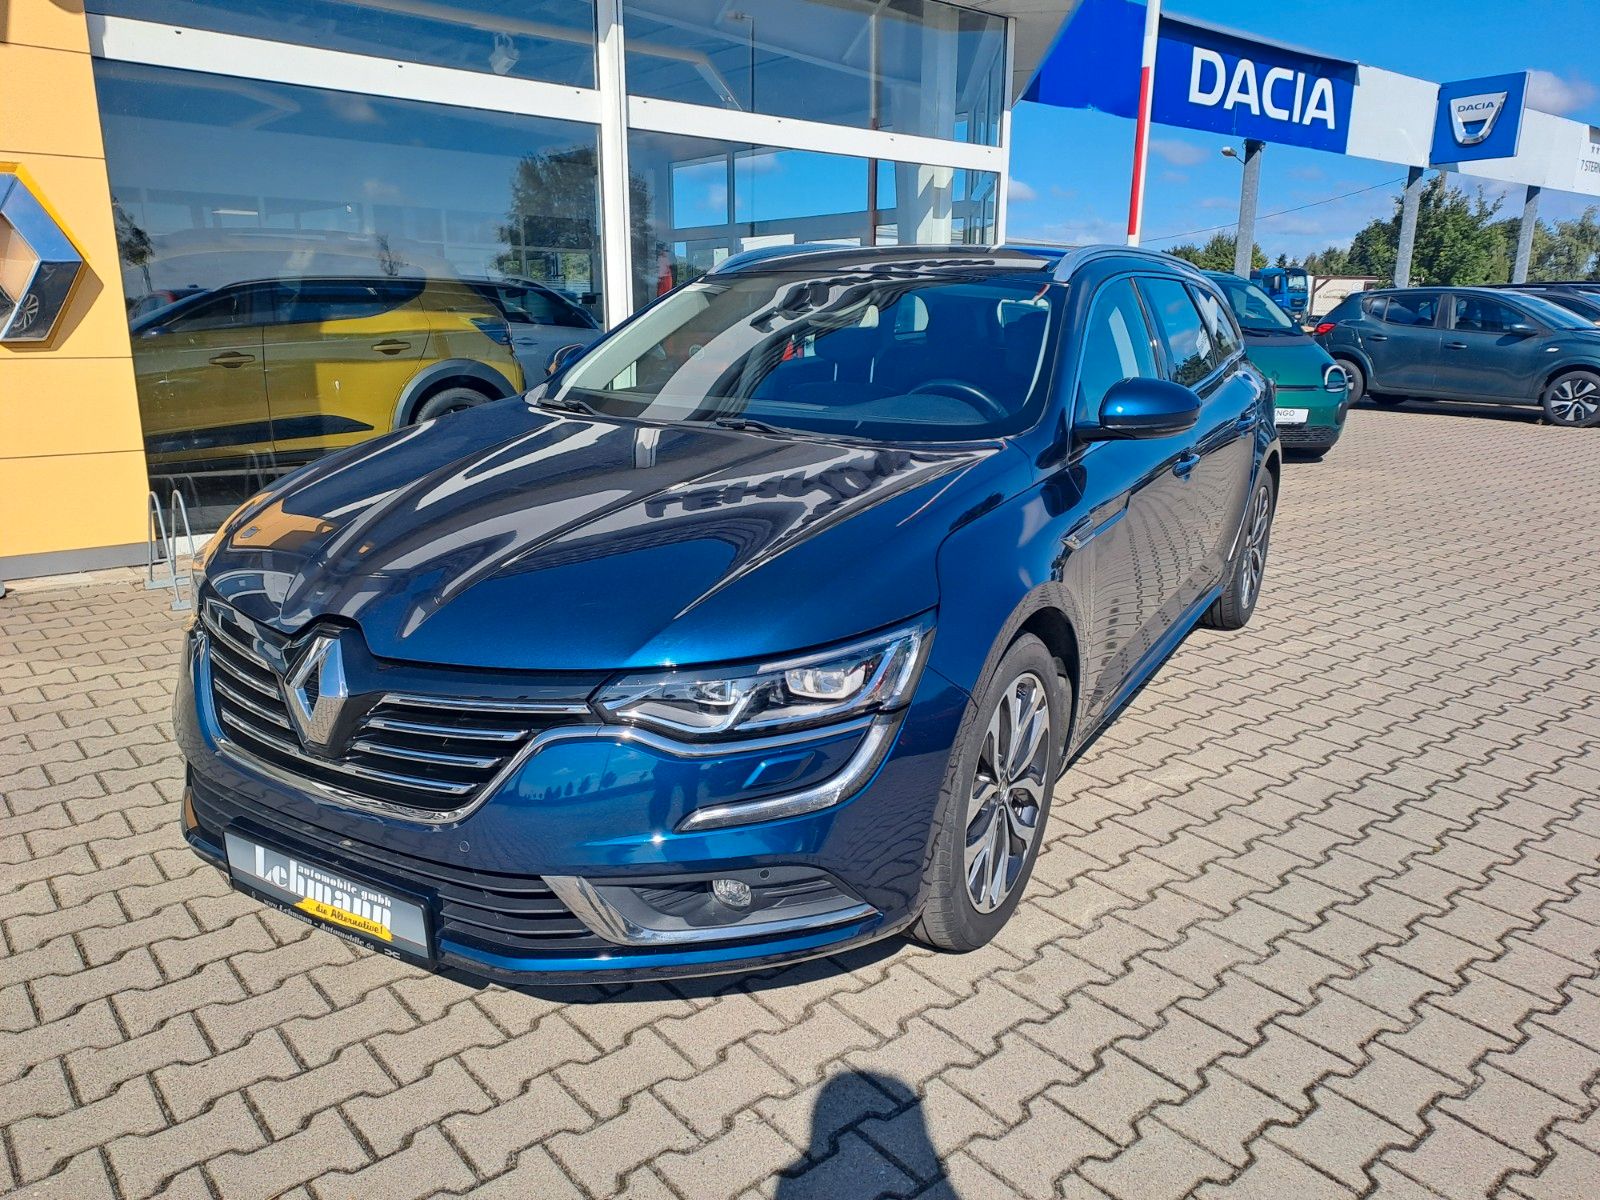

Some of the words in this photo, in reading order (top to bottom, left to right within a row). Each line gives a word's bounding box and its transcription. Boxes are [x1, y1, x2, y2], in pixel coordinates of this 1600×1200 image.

[1188, 46, 1336, 130] DACIA
[1457, 101, 1495, 113] DACIA
[255, 845, 392, 932] Lehmann
[298, 865, 358, 894] automobile
[361, 890, 392, 908] gmbh
